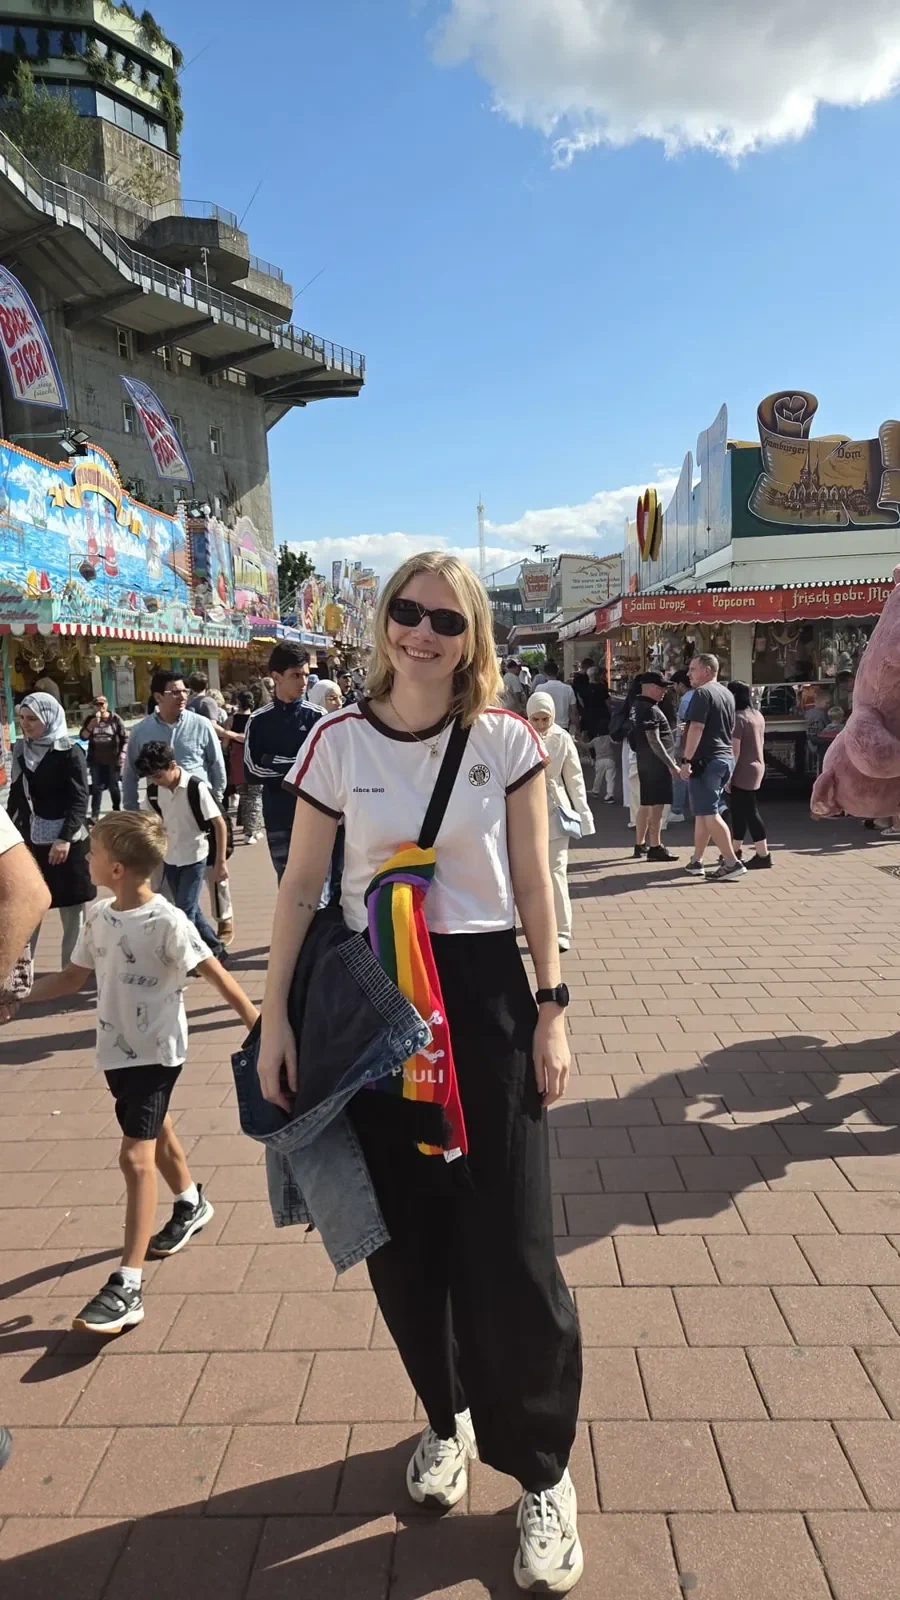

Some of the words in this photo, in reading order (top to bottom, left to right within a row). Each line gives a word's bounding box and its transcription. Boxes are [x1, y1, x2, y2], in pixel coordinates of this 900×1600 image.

[10, 340, 48, 394] FISCH
[762, 436, 807, 455] Hamburger
[837, 447, 861, 459] Dom
[630, 598, 656, 612] Salmi
[659, 598, 686, 612] Drops
[712, 594, 756, 610] Popcorn
[792, 588, 830, 608] frisch
[833, 586, 866, 604] gebr.
[866, 587, 891, 603] Ma
[391, 1066, 444, 1083] PAULI
